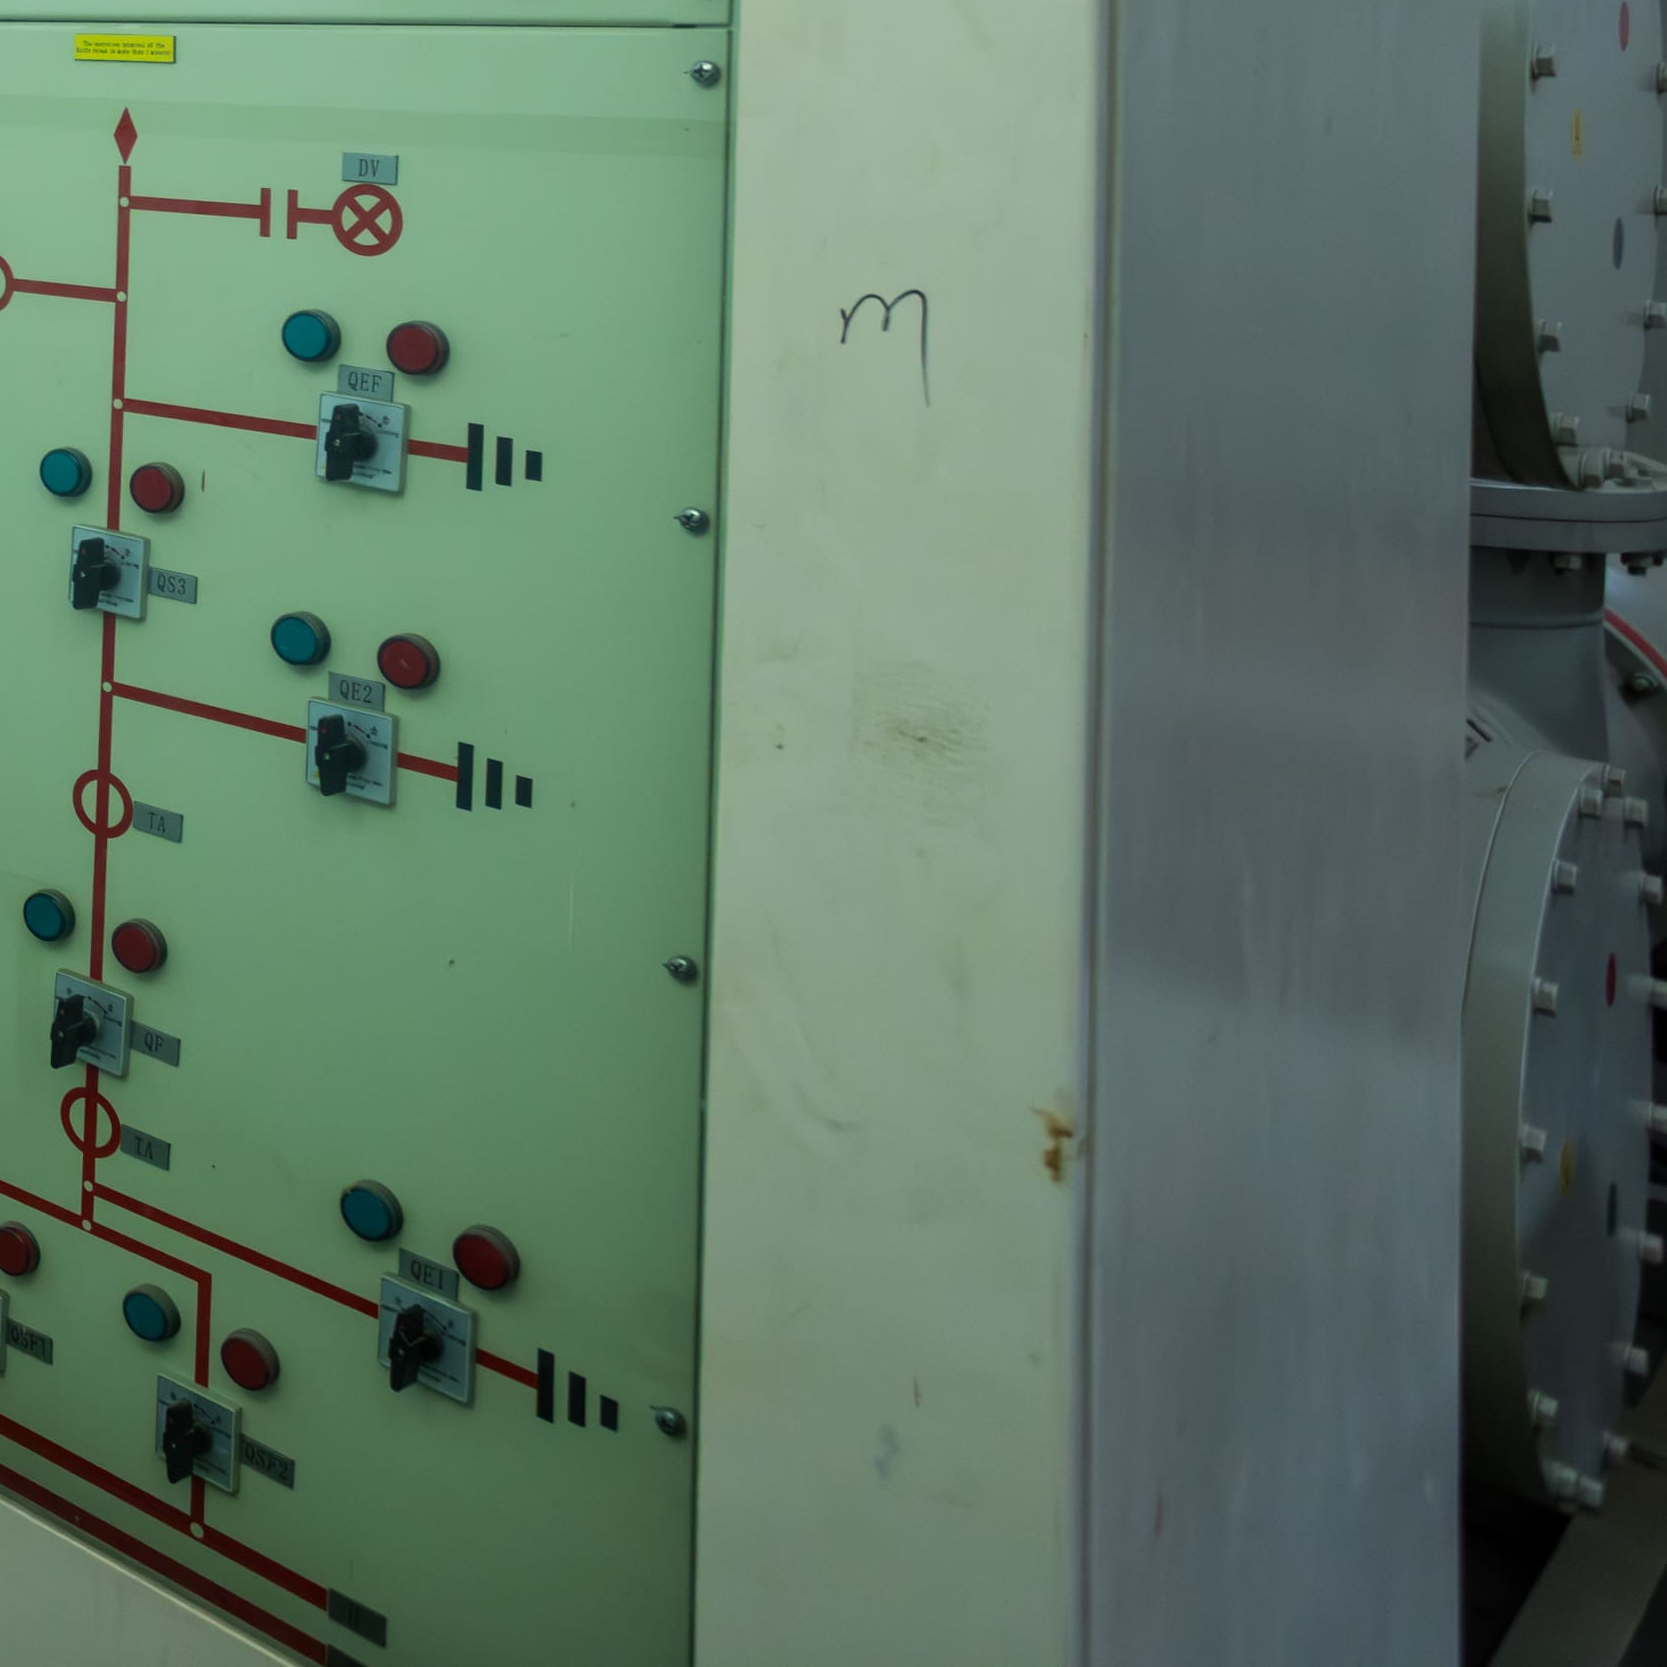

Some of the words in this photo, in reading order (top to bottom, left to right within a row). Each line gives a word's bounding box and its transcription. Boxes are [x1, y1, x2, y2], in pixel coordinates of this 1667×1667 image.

[359, 158, 380, 178] DV
[348, 371, 383, 393] QEF
[157, 573, 186, 596] QS3
[339, 679, 373, 704] QE2
[147, 811, 166, 833] TA
[144, 1032, 164, 1052] QF
[410, 1259, 444, 1290] QE1
[11, 1325, 46, 1357] QSF1
[245, 1443, 288, 1482] QSF2
